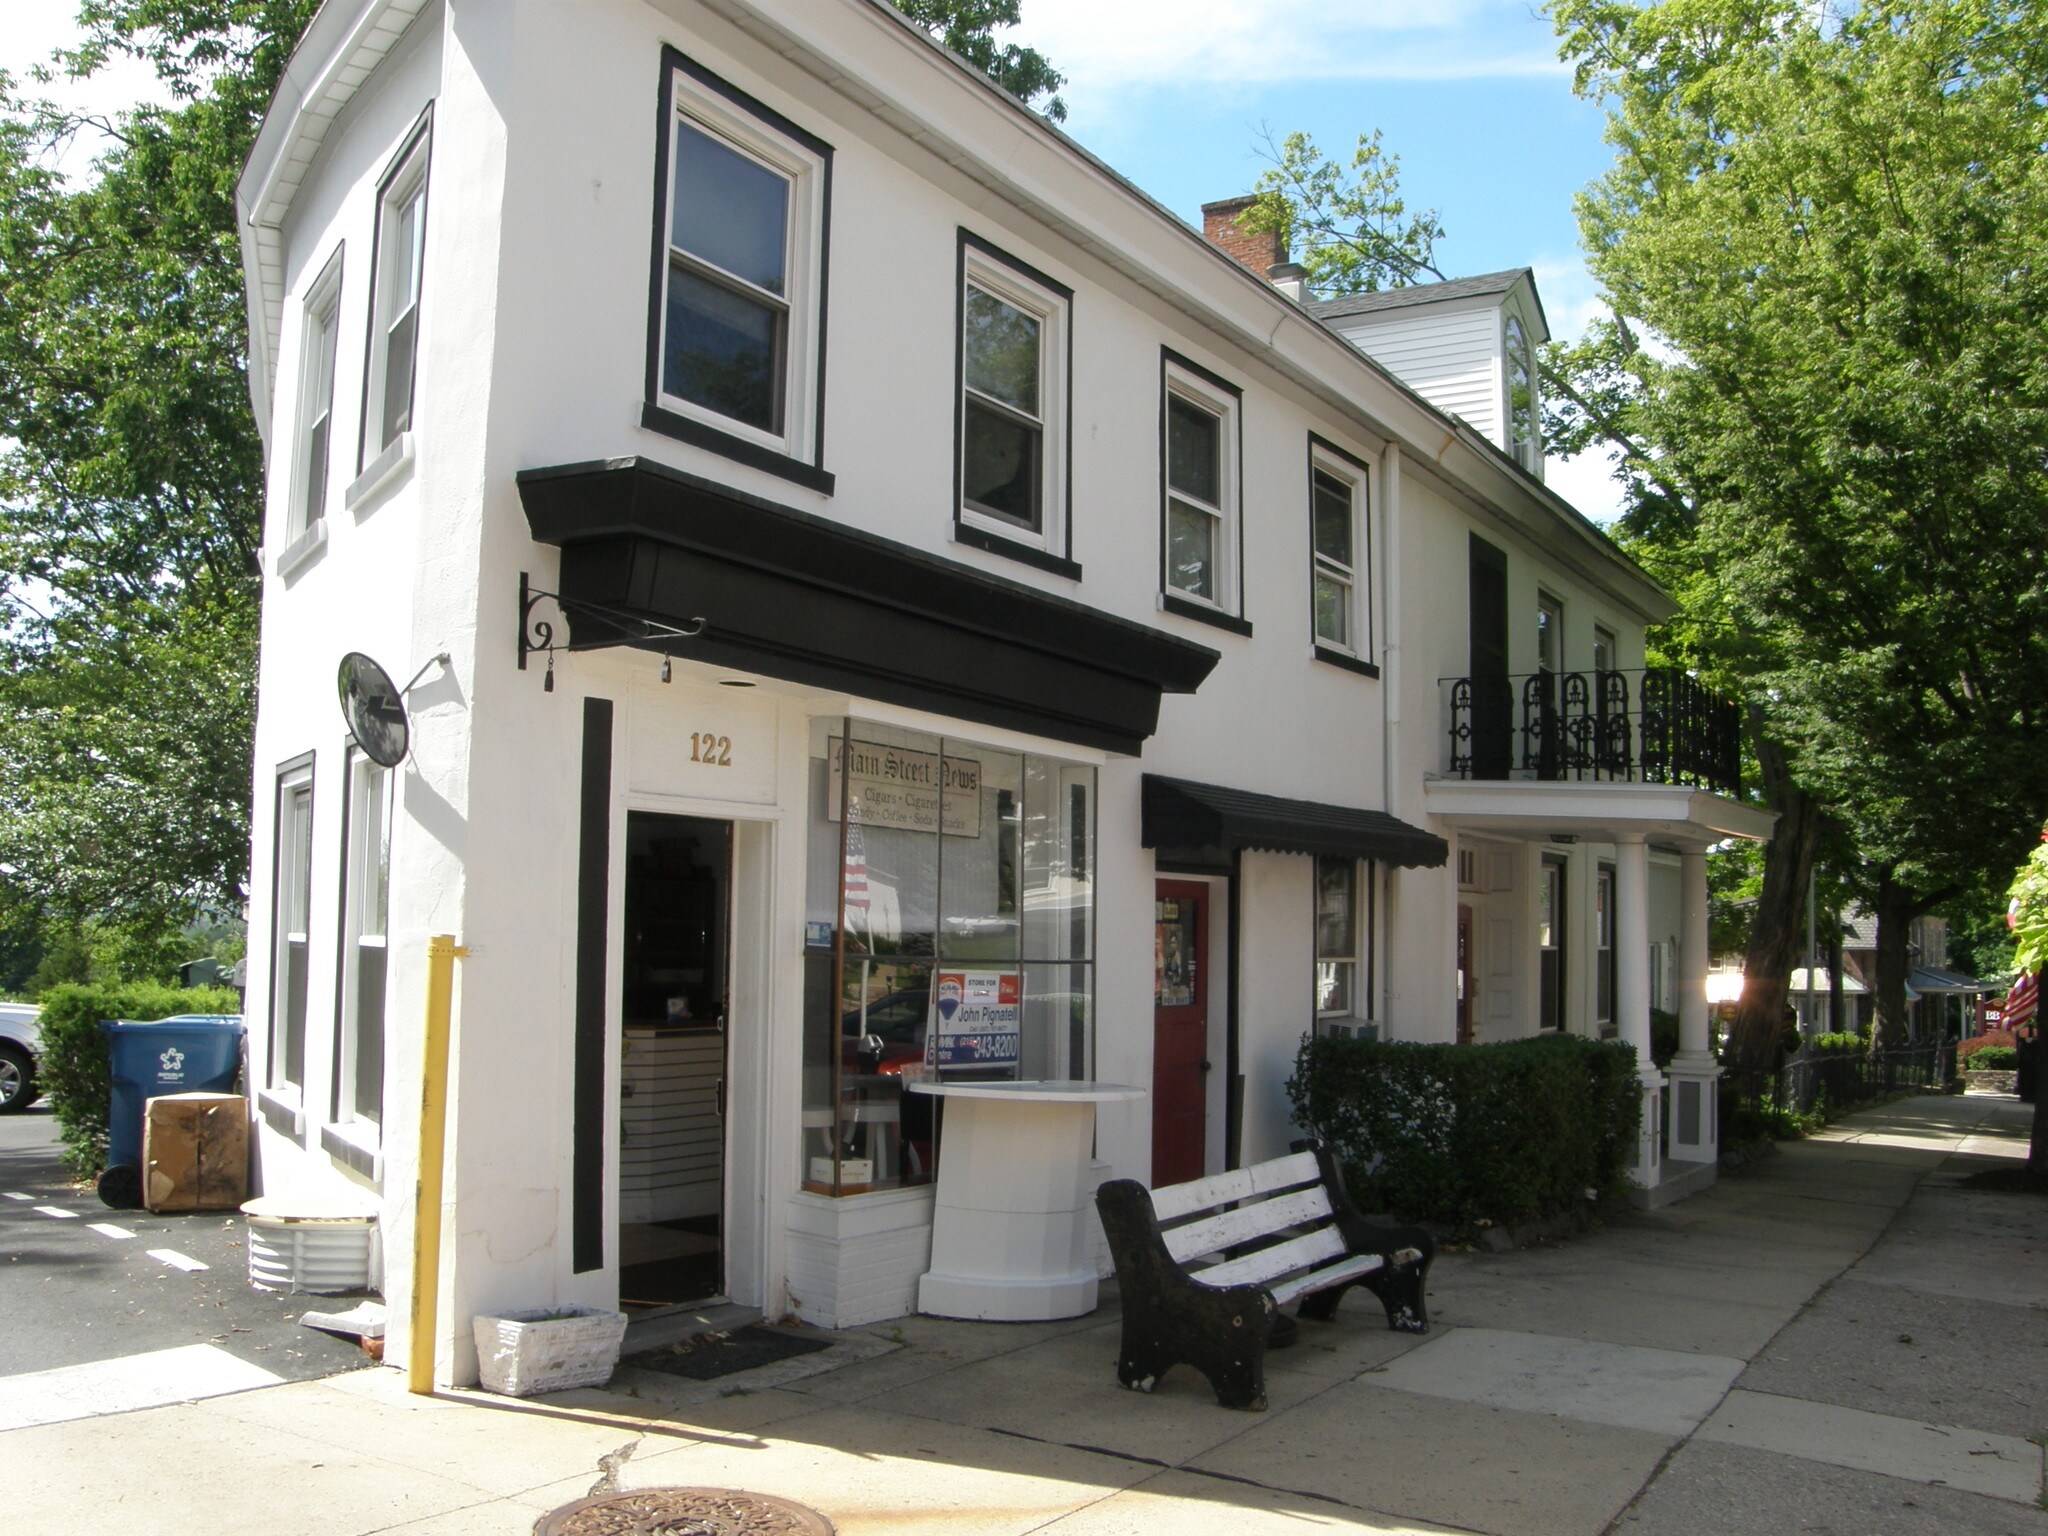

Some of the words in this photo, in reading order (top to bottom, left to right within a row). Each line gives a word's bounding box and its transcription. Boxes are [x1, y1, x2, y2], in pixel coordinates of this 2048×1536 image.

[690, 732, 732, 767] 122
[884, 751, 930, 783] Street
[864, 787, 897, 805] Cigars
[882, 809, 908, 822] Coffee
[914, 812, 933, 825] Soda
[958, 1006, 980, 1022] John
[928, 1049, 953, 1061] Cntre
[975, 1035, 1017, 1059] 343-8200
